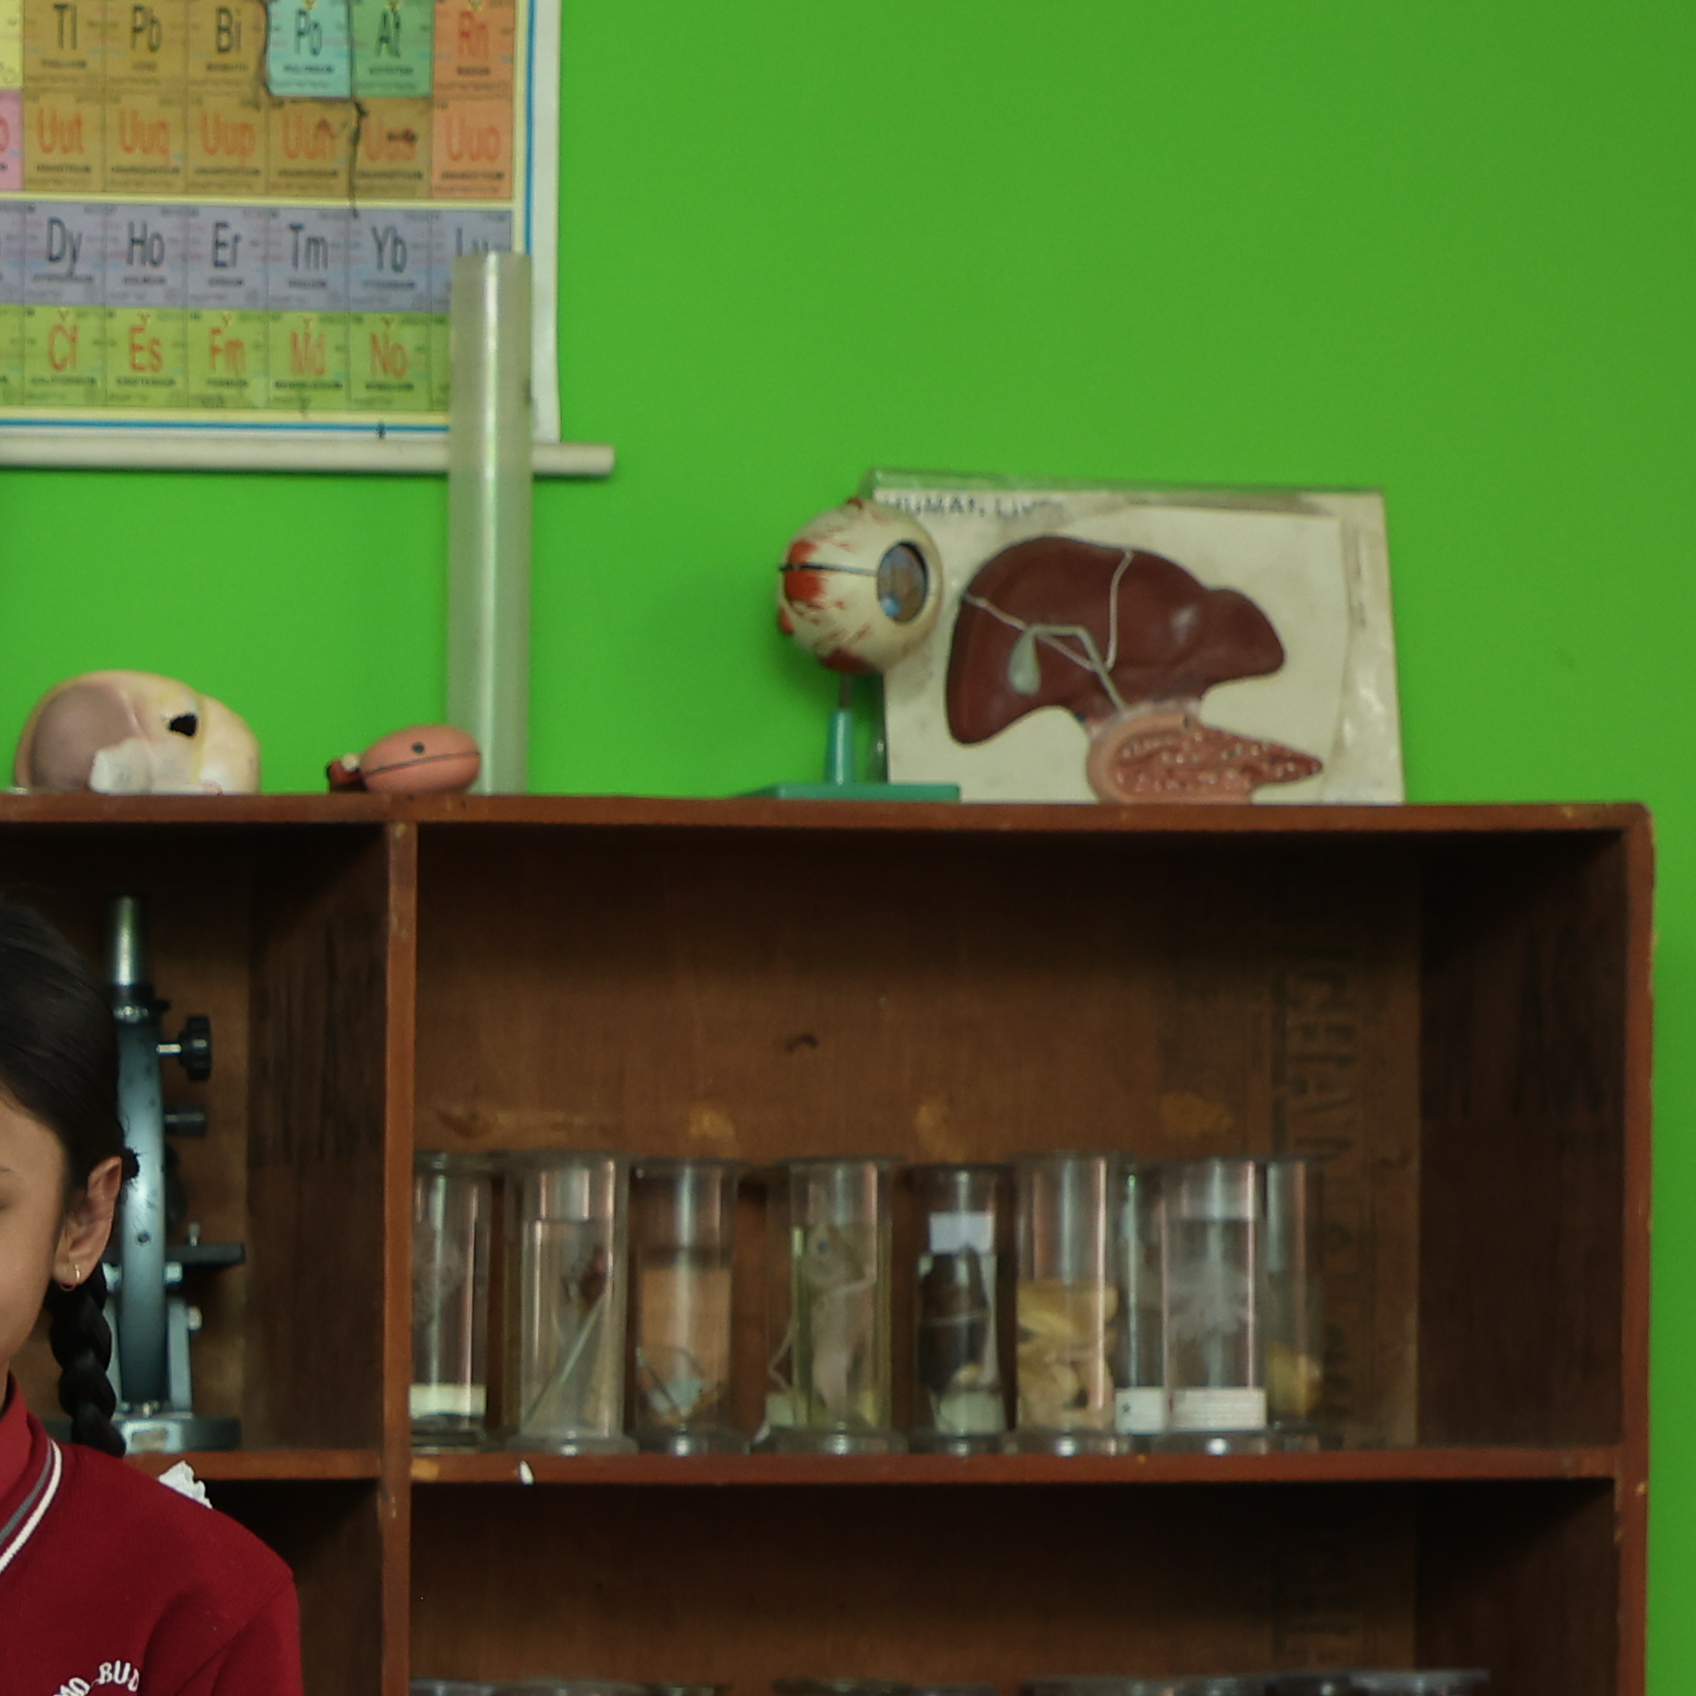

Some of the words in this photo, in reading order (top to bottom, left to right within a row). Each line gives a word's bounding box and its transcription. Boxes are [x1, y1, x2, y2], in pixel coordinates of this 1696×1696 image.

[54, 3, 78, 50] Tl
[131, 6, 163, 53] Pb
[216, 7, 242, 55] Bi
[446, 113, 502, 162] Uuo
[47, 217, 84, 277] Dy
[126, 221, 166, 269] Ho
[212, 222, 242, 269] Er
[289, 223, 329, 271] Tm
[371, 226, 407, 274] Yb
[47, 324, 79, 372] Cf
[128, 326, 163, 374] Es
[210, 327, 247, 373] Fm
[371, 333, 408, 377] No
[97, 1659, 139, 1692] BUD
